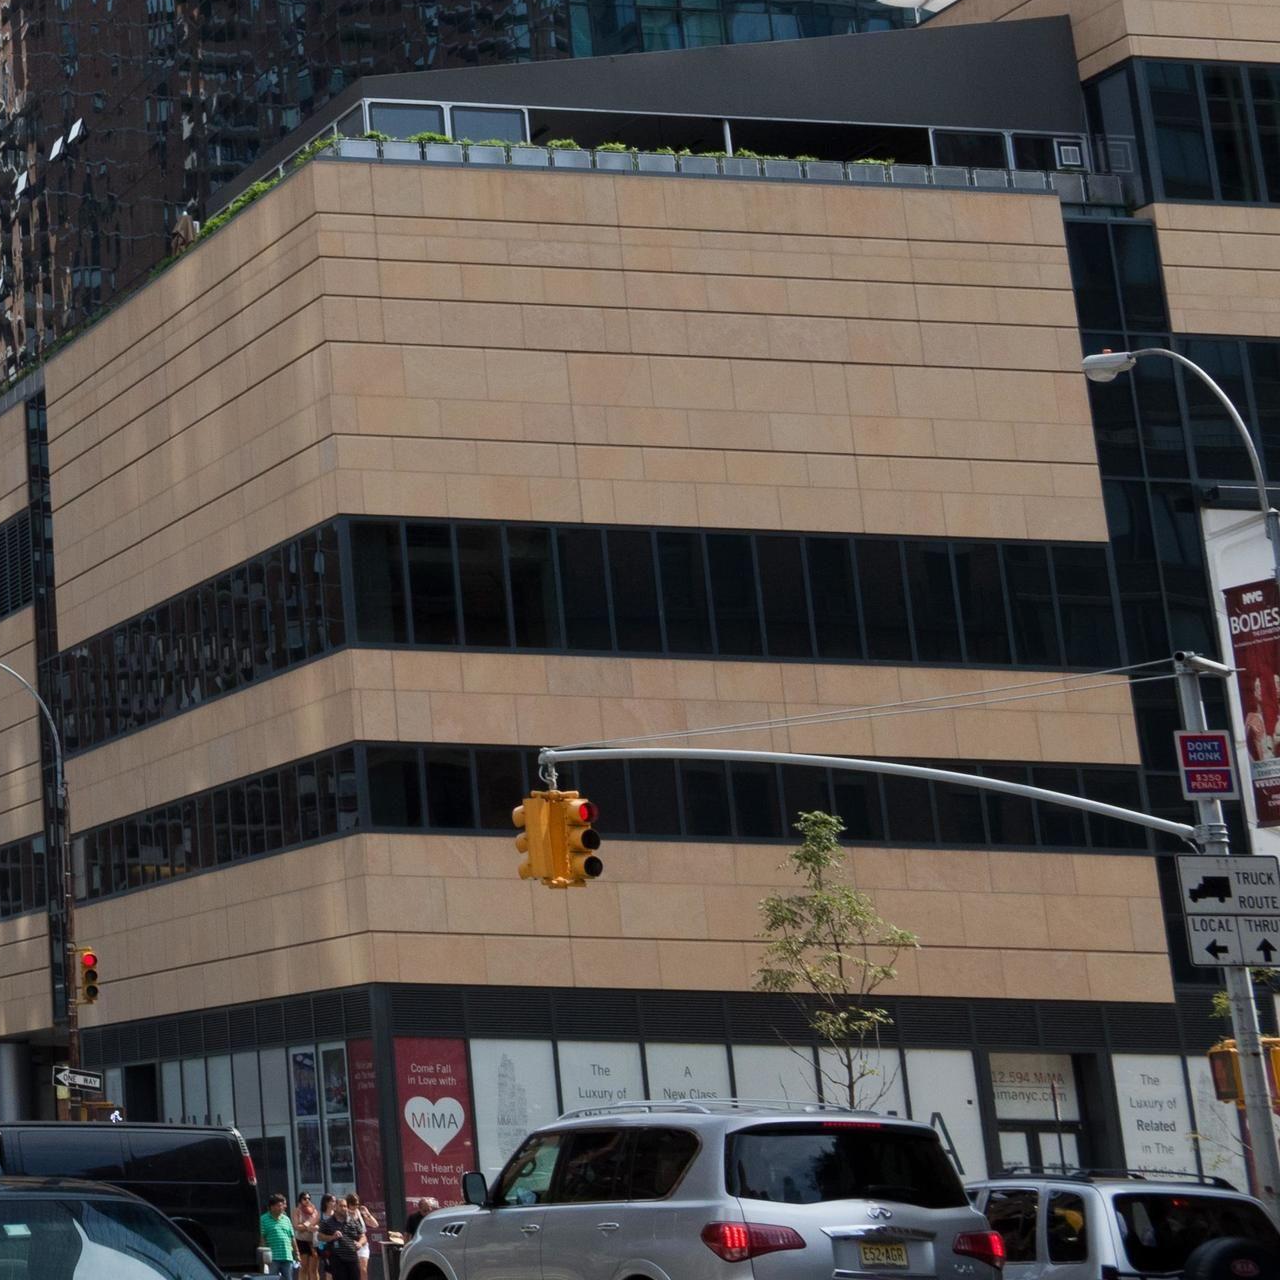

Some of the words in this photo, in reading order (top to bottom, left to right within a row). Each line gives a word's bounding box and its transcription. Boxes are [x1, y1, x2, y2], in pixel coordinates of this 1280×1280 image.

[1242, 590, 1263, 605] NYC
[1230, 607, 1280, 635] BODIES
[1188, 751, 1221, 761] HONK
[1191, 781, 1228, 789] PENALTY
[1235, 871, 1275, 885] TRUCK
[1239, 895, 1280, 909] ROUTE
[1191, 918, 1233, 932] LOCAL
[1244, 919, 1280, 932] THRU
[410, 1063, 434, 1073] Come
[436, 1063, 452, 1073] Fall
[590, 1063, 611, 1076] The
[684, 1066, 692, 1078] A
[63, 1073, 77, 1083] ONE
[407, 1075, 416, 1085] in
[418, 1075, 437, 1086] Love
[438, 1076, 457, 1087] with
[1140, 1073, 1160, 1086] The
[578, 1087, 614, 1100] Luxury
[616, 1087, 627, 1099] of
[663, 1088, 686, 1099] New
[689, 1088, 718, 1099] Class
[1129, 1097, 1164, 1111] Luxury
[1167, 1097, 1177, 1109] of
[411, 1112, 459, 1129] MiMA
[1136, 1119, 1177, 1132] Related
[1142, 1143, 1151, 1154] in
[1154, 1142, 1175, 1155] The
[413, 1162, 429, 1173] The
[431, 1163, 454, 1173] Heart
[455, 1163, 464, 1173] of
[421, 1175, 439, 1185] New
[440, 1175, 459, 1185] York
